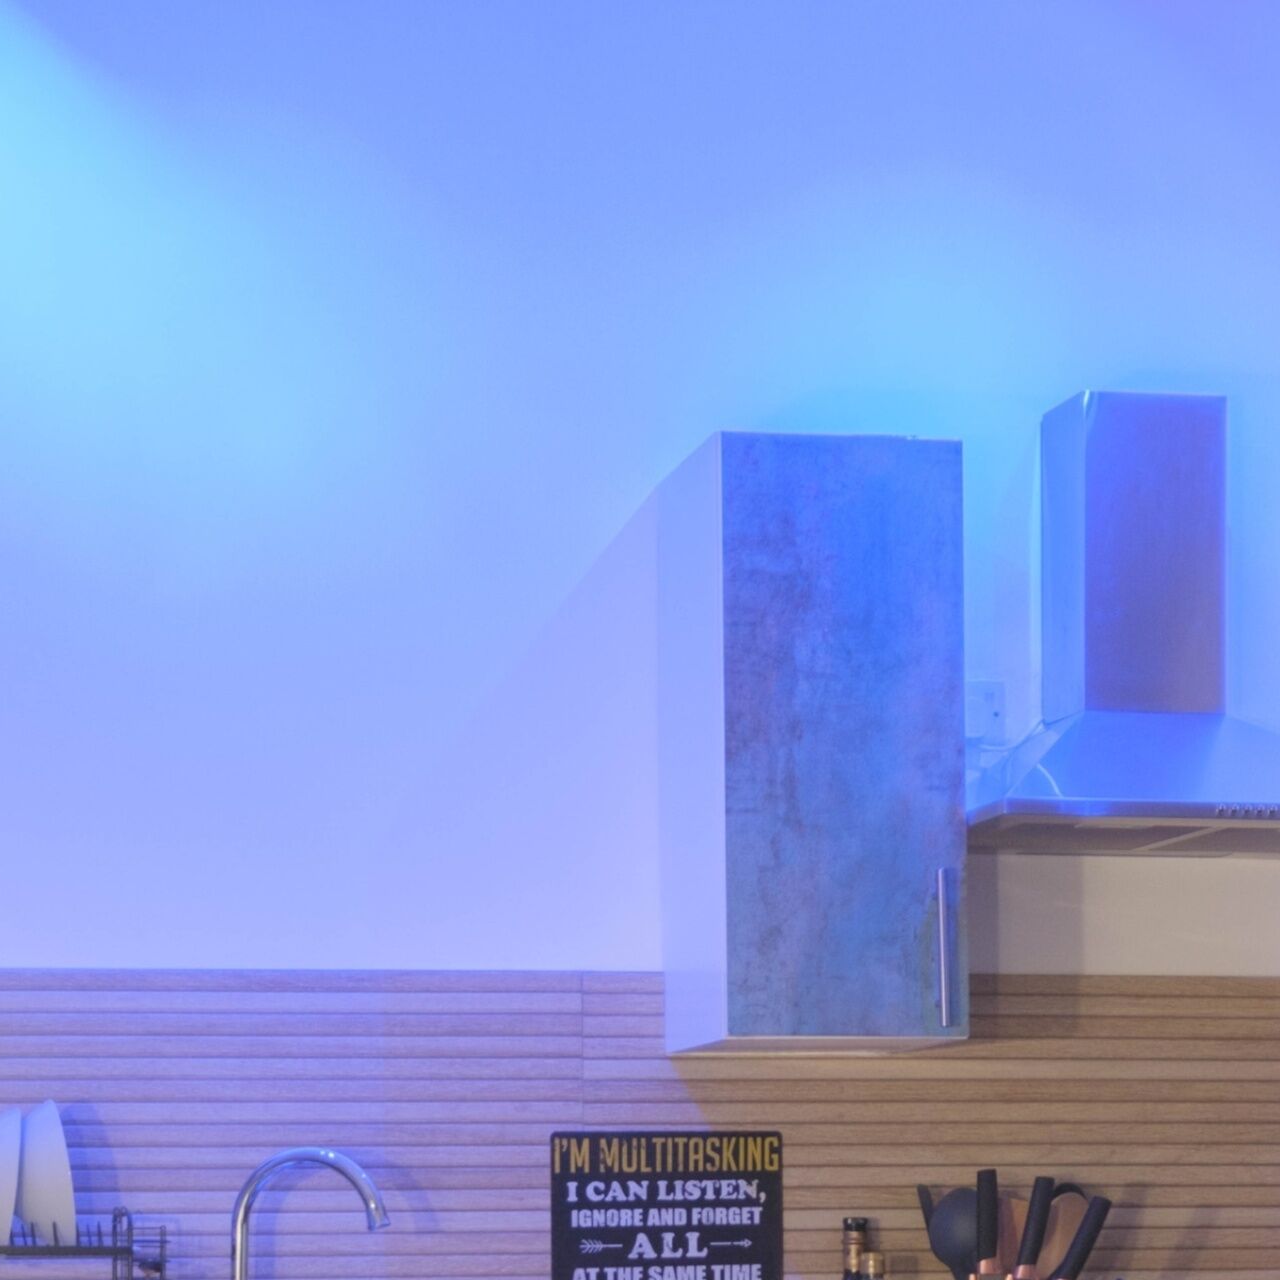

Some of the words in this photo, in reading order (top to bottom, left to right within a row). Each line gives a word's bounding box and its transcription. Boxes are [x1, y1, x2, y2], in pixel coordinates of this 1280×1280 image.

[599, 1135, 780, 1174] MULTITASKING
[566, 1181, 579, 1202] I
[585, 1180, 649, 1202] CAN
[656, 1178, 767, 1203] LISTEN,
[571, 1208, 644, 1228] IGNORE
[646, 1207, 688, 1227] AND
[691, 1206, 763, 1226] FORGET
[627, 1231, 709, 1259] ALL
